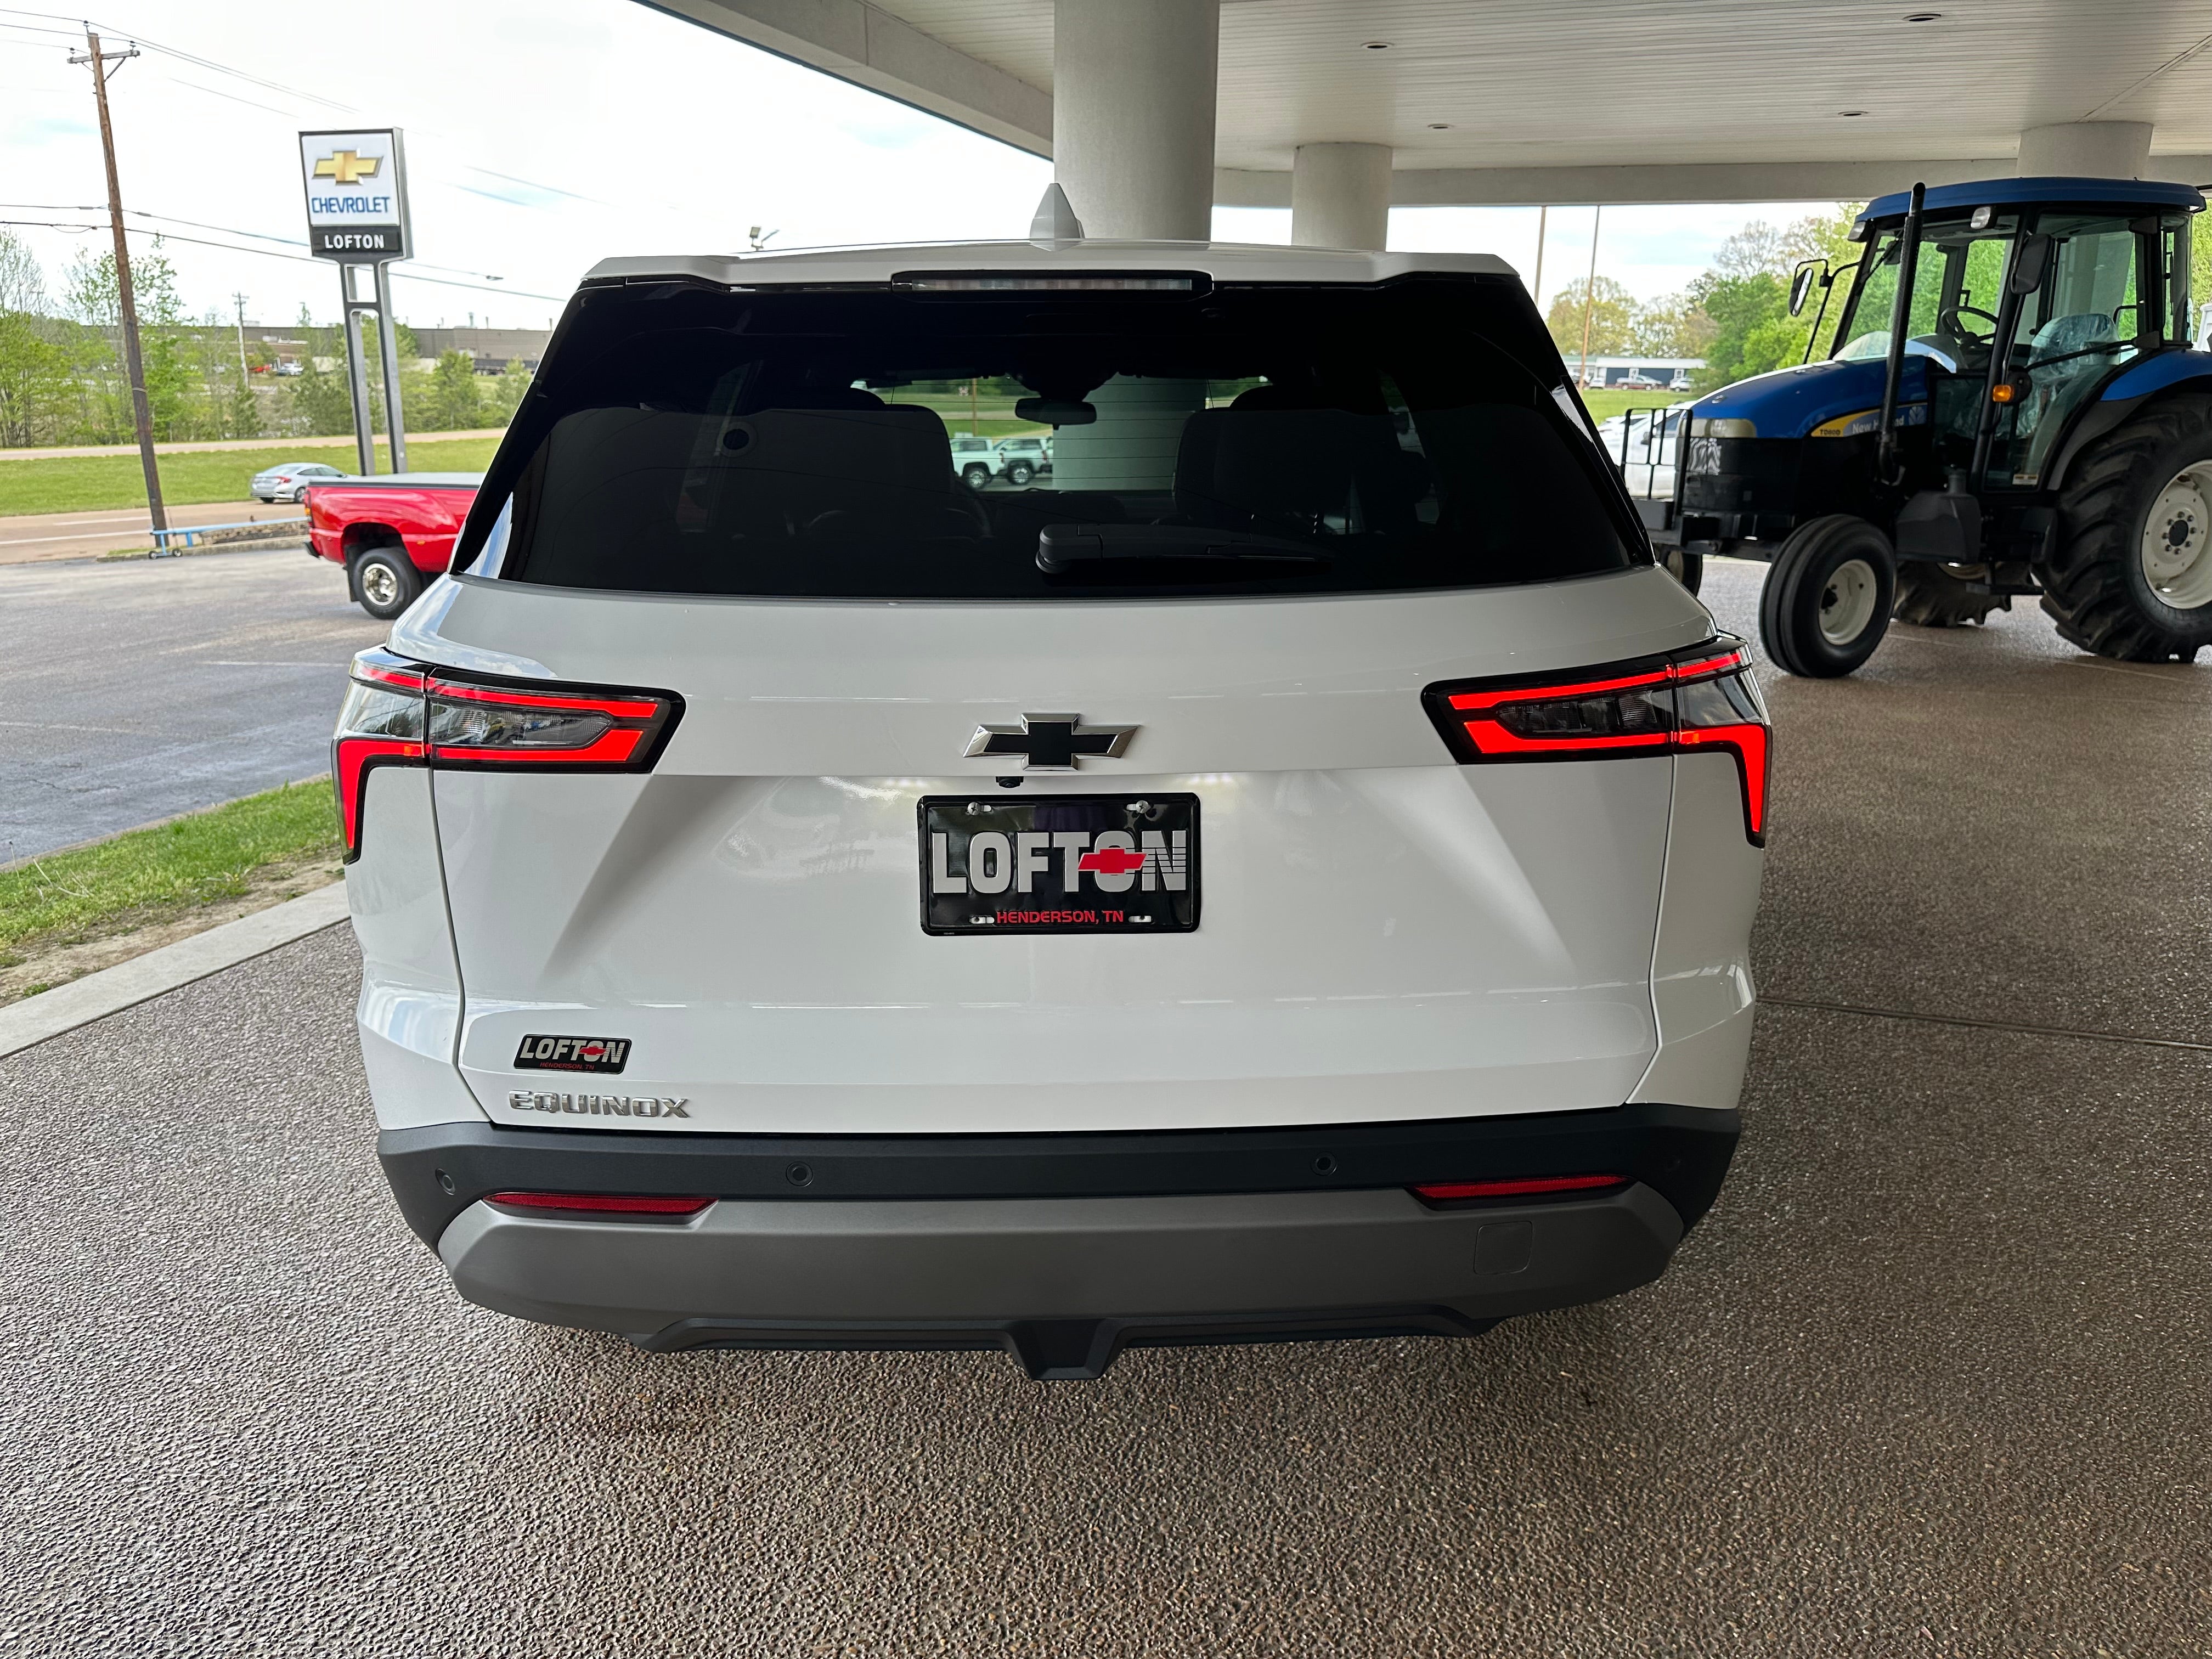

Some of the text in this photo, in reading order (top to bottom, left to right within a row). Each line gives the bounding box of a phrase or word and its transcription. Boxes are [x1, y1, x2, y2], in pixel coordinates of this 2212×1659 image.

[311, 196, 390, 213] CHEVROLET
[324, 234, 385, 249] LOFTON
[932, 830, 1186, 893] LOFTON
[996, 910, 1124, 924] HENDERSON, TN
[520, 1037, 625, 1063] LOFTON
[509, 1090, 689, 1118] EQUINOX
